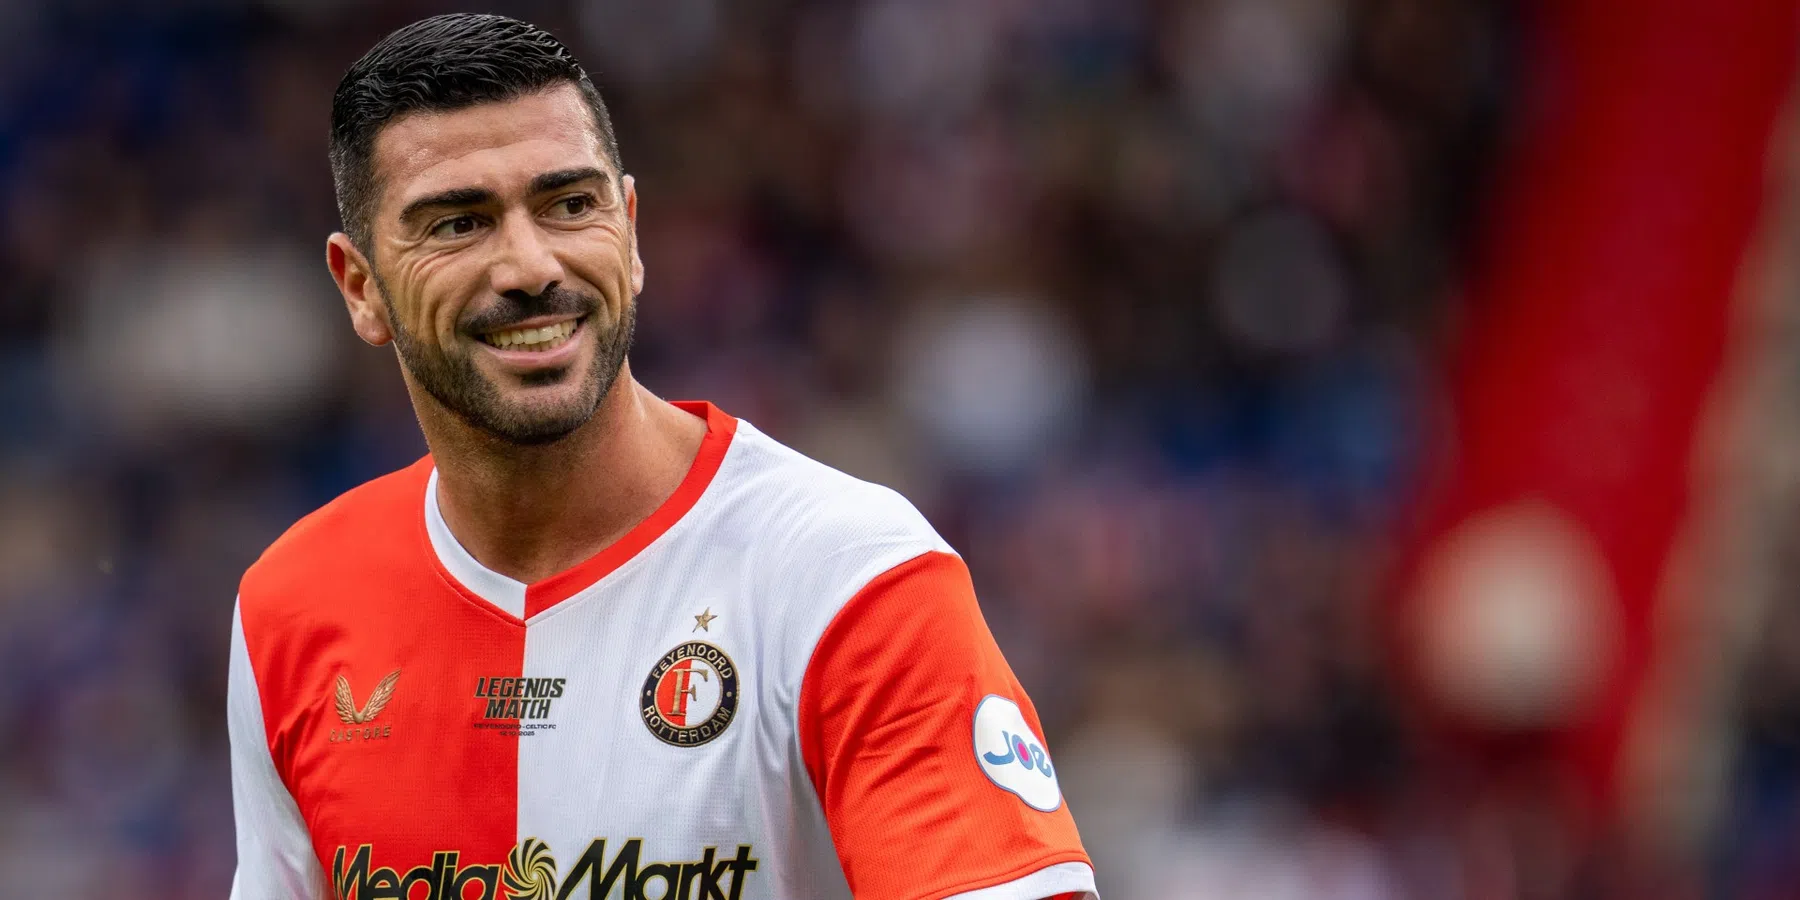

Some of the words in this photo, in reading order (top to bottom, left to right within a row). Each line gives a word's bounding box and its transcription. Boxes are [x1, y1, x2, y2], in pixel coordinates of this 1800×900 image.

[652, 644, 733, 679] FEYENOORD
[475, 677, 567, 698] LEGENDS
[667, 668, 708, 716] F
[484, 698, 552, 719] MATCH
[329, 725, 392, 742] CASTORE
[644, 705, 731, 743] ROTTERDAM
